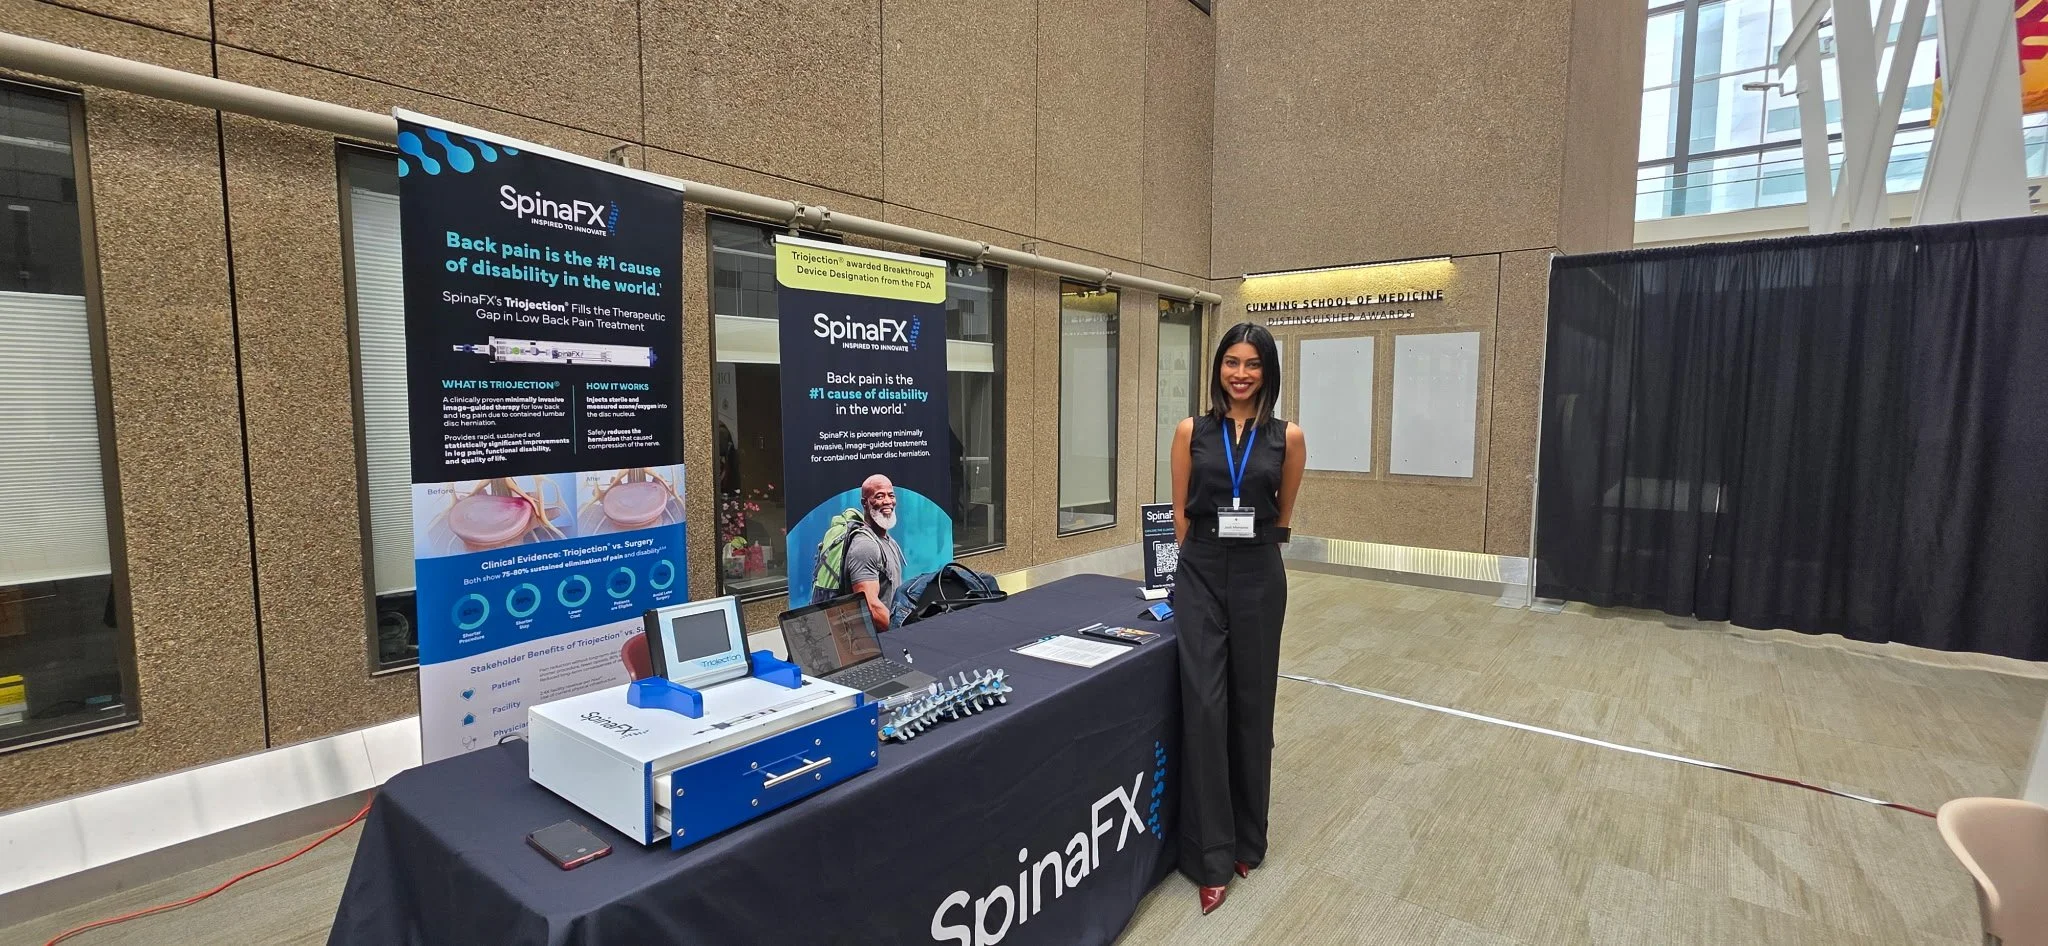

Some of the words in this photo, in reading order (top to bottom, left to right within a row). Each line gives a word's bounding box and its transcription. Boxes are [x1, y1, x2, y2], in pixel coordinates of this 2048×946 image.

[500, 185, 606, 227] SpinaFX
[531, 218, 562, 228] INSPIRED
[574, 225, 606, 236] INNOVATE
[447, 232, 497, 254] Back
[502, 241, 540, 261] pain
[545, 247, 559, 262] is
[564, 250, 592, 267] the
[597, 255, 615, 271] #1
[619, 260, 661, 277] cause
[446, 256, 467, 272] of
[472, 259, 559, 287] disability
[563, 271, 578, 287] in
[583, 274, 611, 290] the
[846, 260, 881, 271] awarded
[884, 265, 934, 279] Breakthrough
[797, 266, 827, 277] Device
[830, 270, 879, 284] Designation
[881, 276, 899, 286] from
[901, 278, 914, 288] the
[915, 281, 932, 290] FDA
[442, 291, 502, 306] SpinaFX's
[572, 304, 591, 314] Fills
[593, 306, 610, 316] the
[612, 307, 666, 322] Therapeutic
[1246, 300, 1298, 312] CUMMING
[1303, 298, 1350, 309] SCHOOL
[1357, 295, 1372, 304] OF
[1379, 290, 1444, 304] MEDICINE
[476, 309, 500, 322] Gap
[503, 312, 513, 321] in
[516, 313, 539, 323] Low
[543, 314, 570, 326] Back
[572, 317, 594, 328] Pain
[596, 319, 644, 332] Treatment
[1267, 313, 1354, 326] DISTINGUISHED
[1360, 309, 1414, 320] AWARDS
[813, 313, 909, 344] SpinaFX
[843, 342, 870, 350] INSPIRED
[871, 343, 879, 351] TO
[881, 344, 909, 353] INNOVATE
[442, 380, 476, 388] WHAT
[479, 381, 488, 389] IS
[490, 381, 560, 389] TRIOJECTION®
[827, 372, 856, 384] Back
[858, 373, 882, 386] pain
[885, 373, 893, 385] is
[896, 374, 913, 385] the
[809, 387, 824, 399] #1
[827, 391, 862, 399] cause
[864, 388, 877, 399] of
[878, 389, 928, 402] disability
[443, 404, 494, 412] image-guided
[836, 403, 846, 415] in
[849, 404, 869, 415] the
[819, 431, 849, 440] SpinaFX
[857, 431, 892, 439] pioneering
[893, 429, 923, 438] minimally
[445, 441, 488, 449] statistically
[488, 440, 522, 448] significant
[454, 449, 465, 457] leg
[485, 447, 518, 455] functional
[588, 442, 627, 450] compression
[814, 442, 843, 450] invasive,
[844, 441, 893, 450] image-guided
[893, 440, 927, 448] treatments
[823, 453, 859, 462] contained
[860, 452, 883, 460] lumbar
[899, 450, 931, 458] herniation.
[1147, 510, 1173, 522] SpinaF
[481, 557, 515, 570] Clinical
[517, 552, 561, 564] Evidence:
[624, 538, 654, 549] Surgery
[464, 576, 482, 585] Both
[483, 574, 501, 582] show
[530, 562, 564, 573] sustained
[565, 557, 601, 567] elimination
[610, 553, 623, 561] pain
[470, 653, 525, 674] Stakeholder
[528, 644, 565, 659] Benefits
[567, 642, 576, 650] of
[491, 677, 520, 691] Patient
[492, 701, 521, 714] Facility
[931, 771, 1145, 946] SpinaFX
